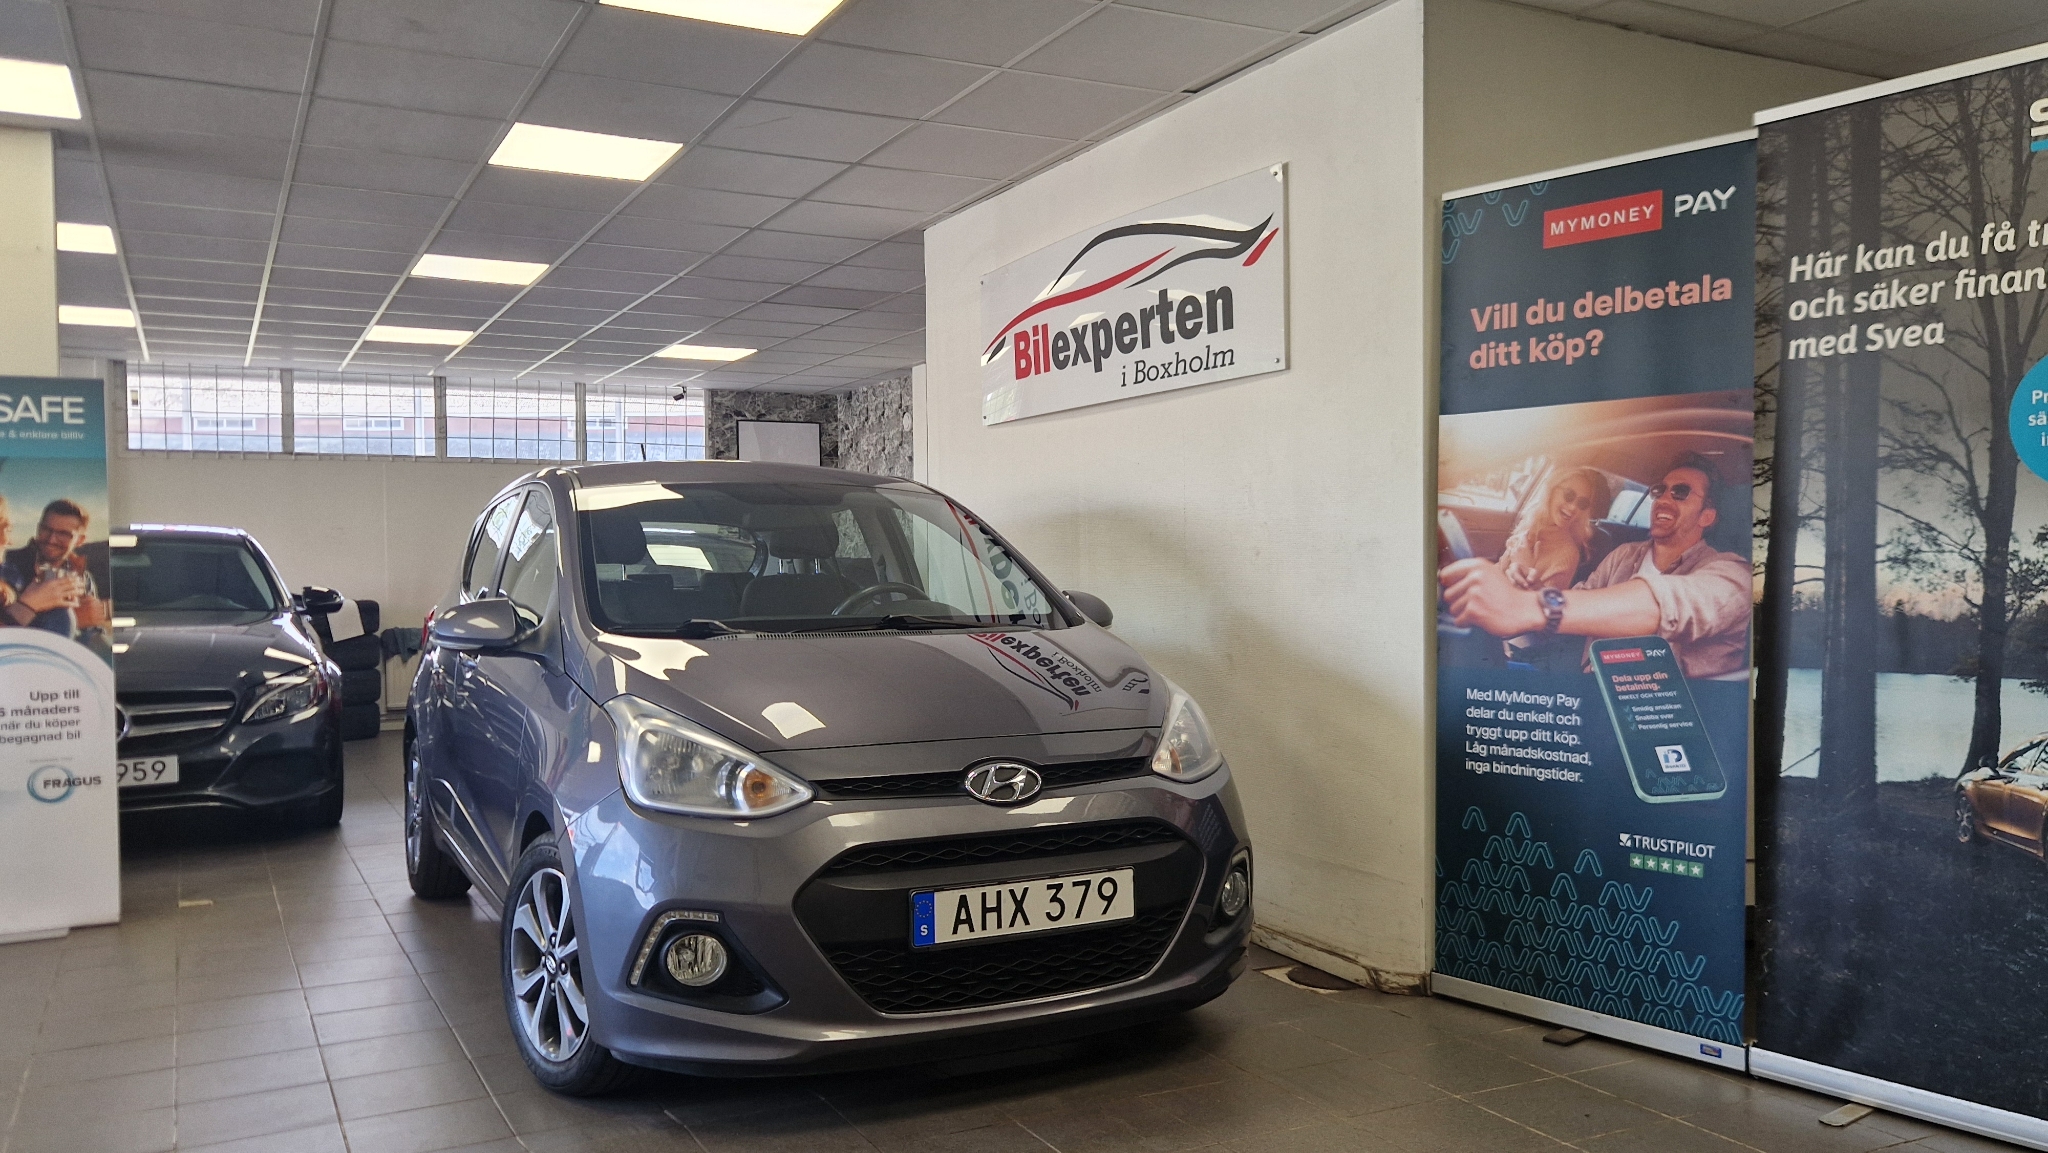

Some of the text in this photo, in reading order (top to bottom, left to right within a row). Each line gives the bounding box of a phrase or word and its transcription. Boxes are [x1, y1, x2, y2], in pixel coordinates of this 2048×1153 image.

[1550, 185, 1737, 236] MYMONEY PAY
[1789, 250, 1848, 283] Här
[1854, 243, 1915, 273] kan
[1925, 230, 1970, 263] du
[1981, 220, 2017, 255] få
[1470, 274, 1732, 332] Vill du delbetala
[1788, 266, 2048, 322] och säker finan
[1013, 285, 1234, 381] Bilexperten
[1787, 321, 1945, 360] med Svea
[1469, 329, 1604, 370] ditt köp?
[1120, 345, 1235, 387] i Boxholm
[0, 393, 86, 425] SAFE
[1603, 652, 1642, 661] MYMONEY
[1612, 671, 1668, 683] Dela upp din
[29, 688, 80, 703] Upp till
[1466, 688, 1580, 710] Med MyMoney Pay
[10, 704, 80, 717] månaders
[1466, 706, 1581, 726] delar du enkelt och
[0, 718, 81, 731] när du köper
[0, 730, 81, 744] begagnad bil
[1466, 723, 1581, 747] tryggt upp ditt köp.
[1465, 741, 1593, 766] Låg månadskostnad,
[43, 775, 102, 789] FRAGUS
[1465, 758, 1584, 783] inga bindningstider.
[1632, 834, 1716, 859] TRUSTPILOT
[951, 876, 1119, 935] AHX 379
[920, 924, 929, 937] S
